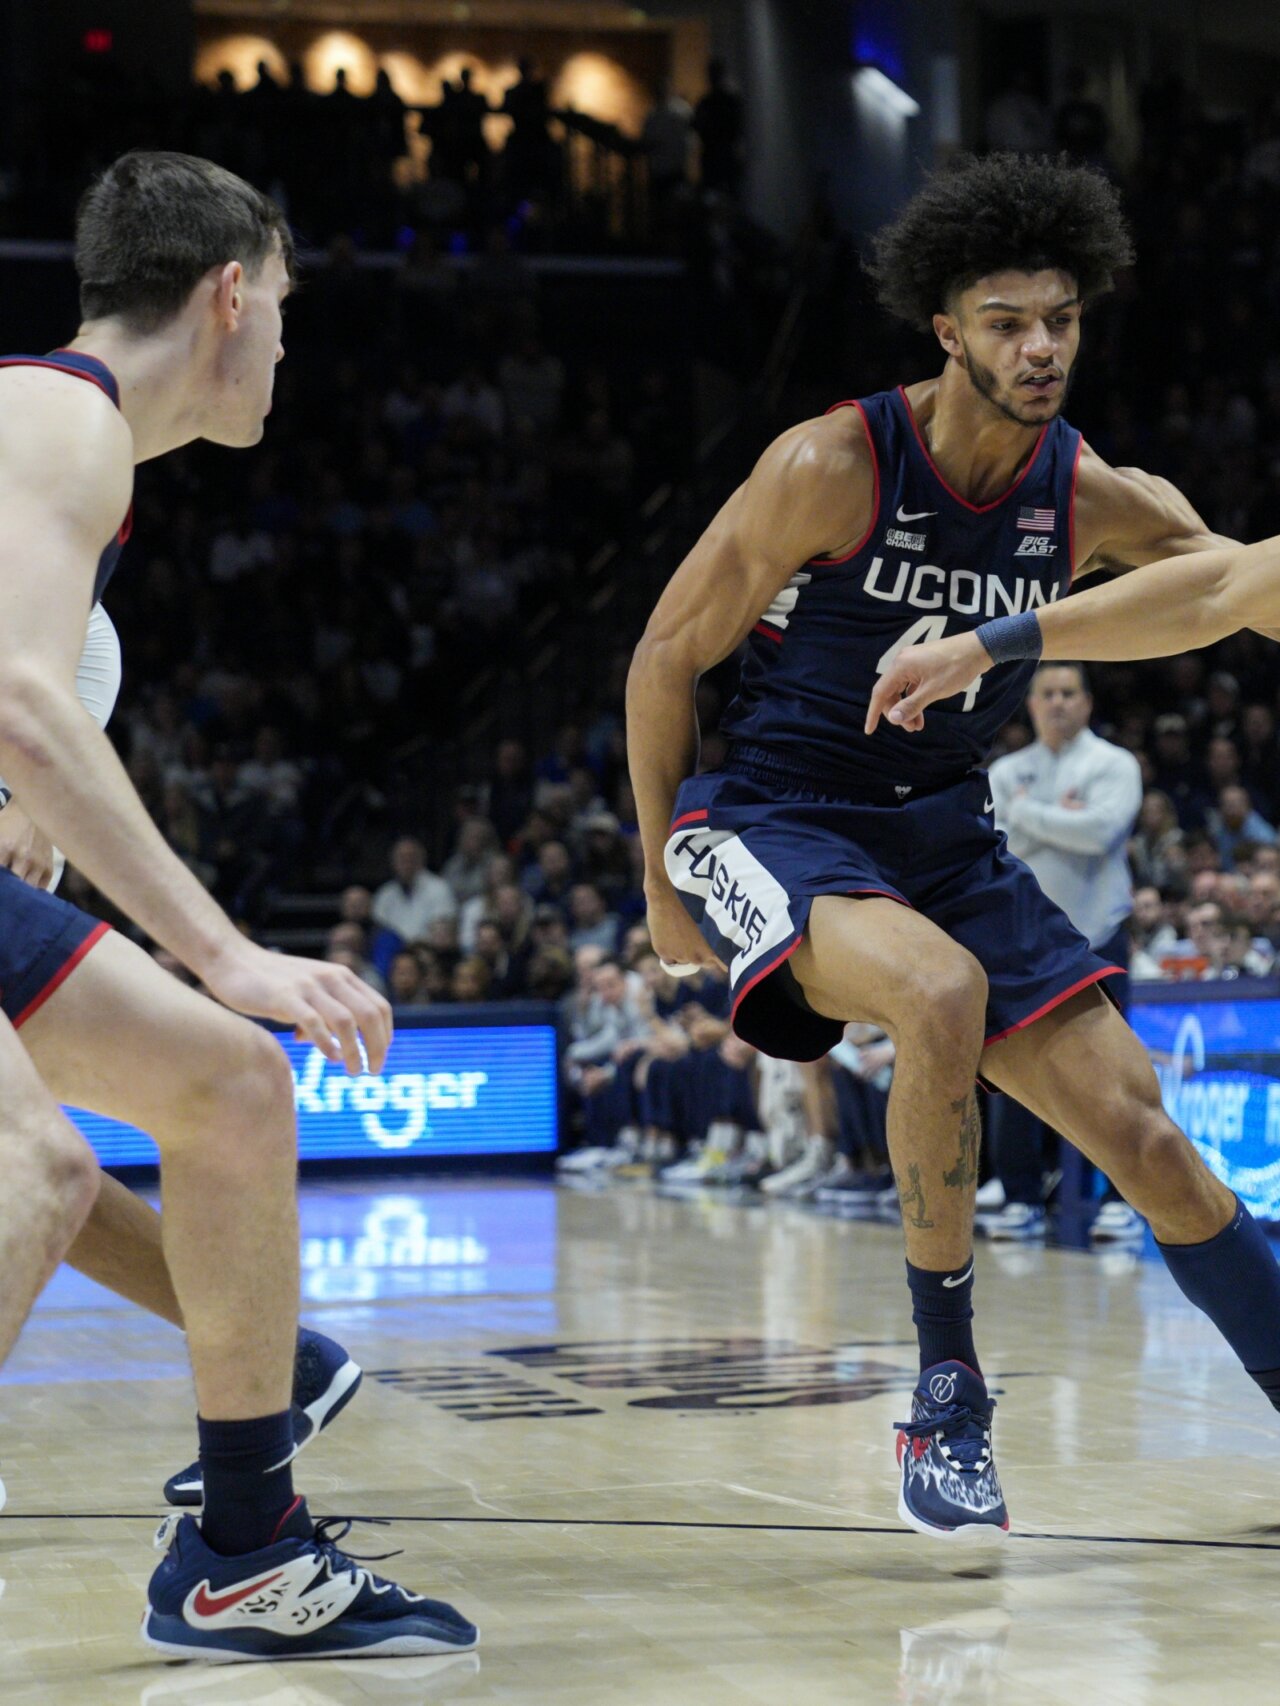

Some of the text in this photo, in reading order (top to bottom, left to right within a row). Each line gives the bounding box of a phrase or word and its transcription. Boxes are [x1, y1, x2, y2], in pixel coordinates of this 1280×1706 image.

[885, 537, 926, 552] CHANGE
[1021, 535, 1051, 546] BIG
[1016, 544, 1058, 555] EAST
[862, 556, 1060, 618] UCONN
